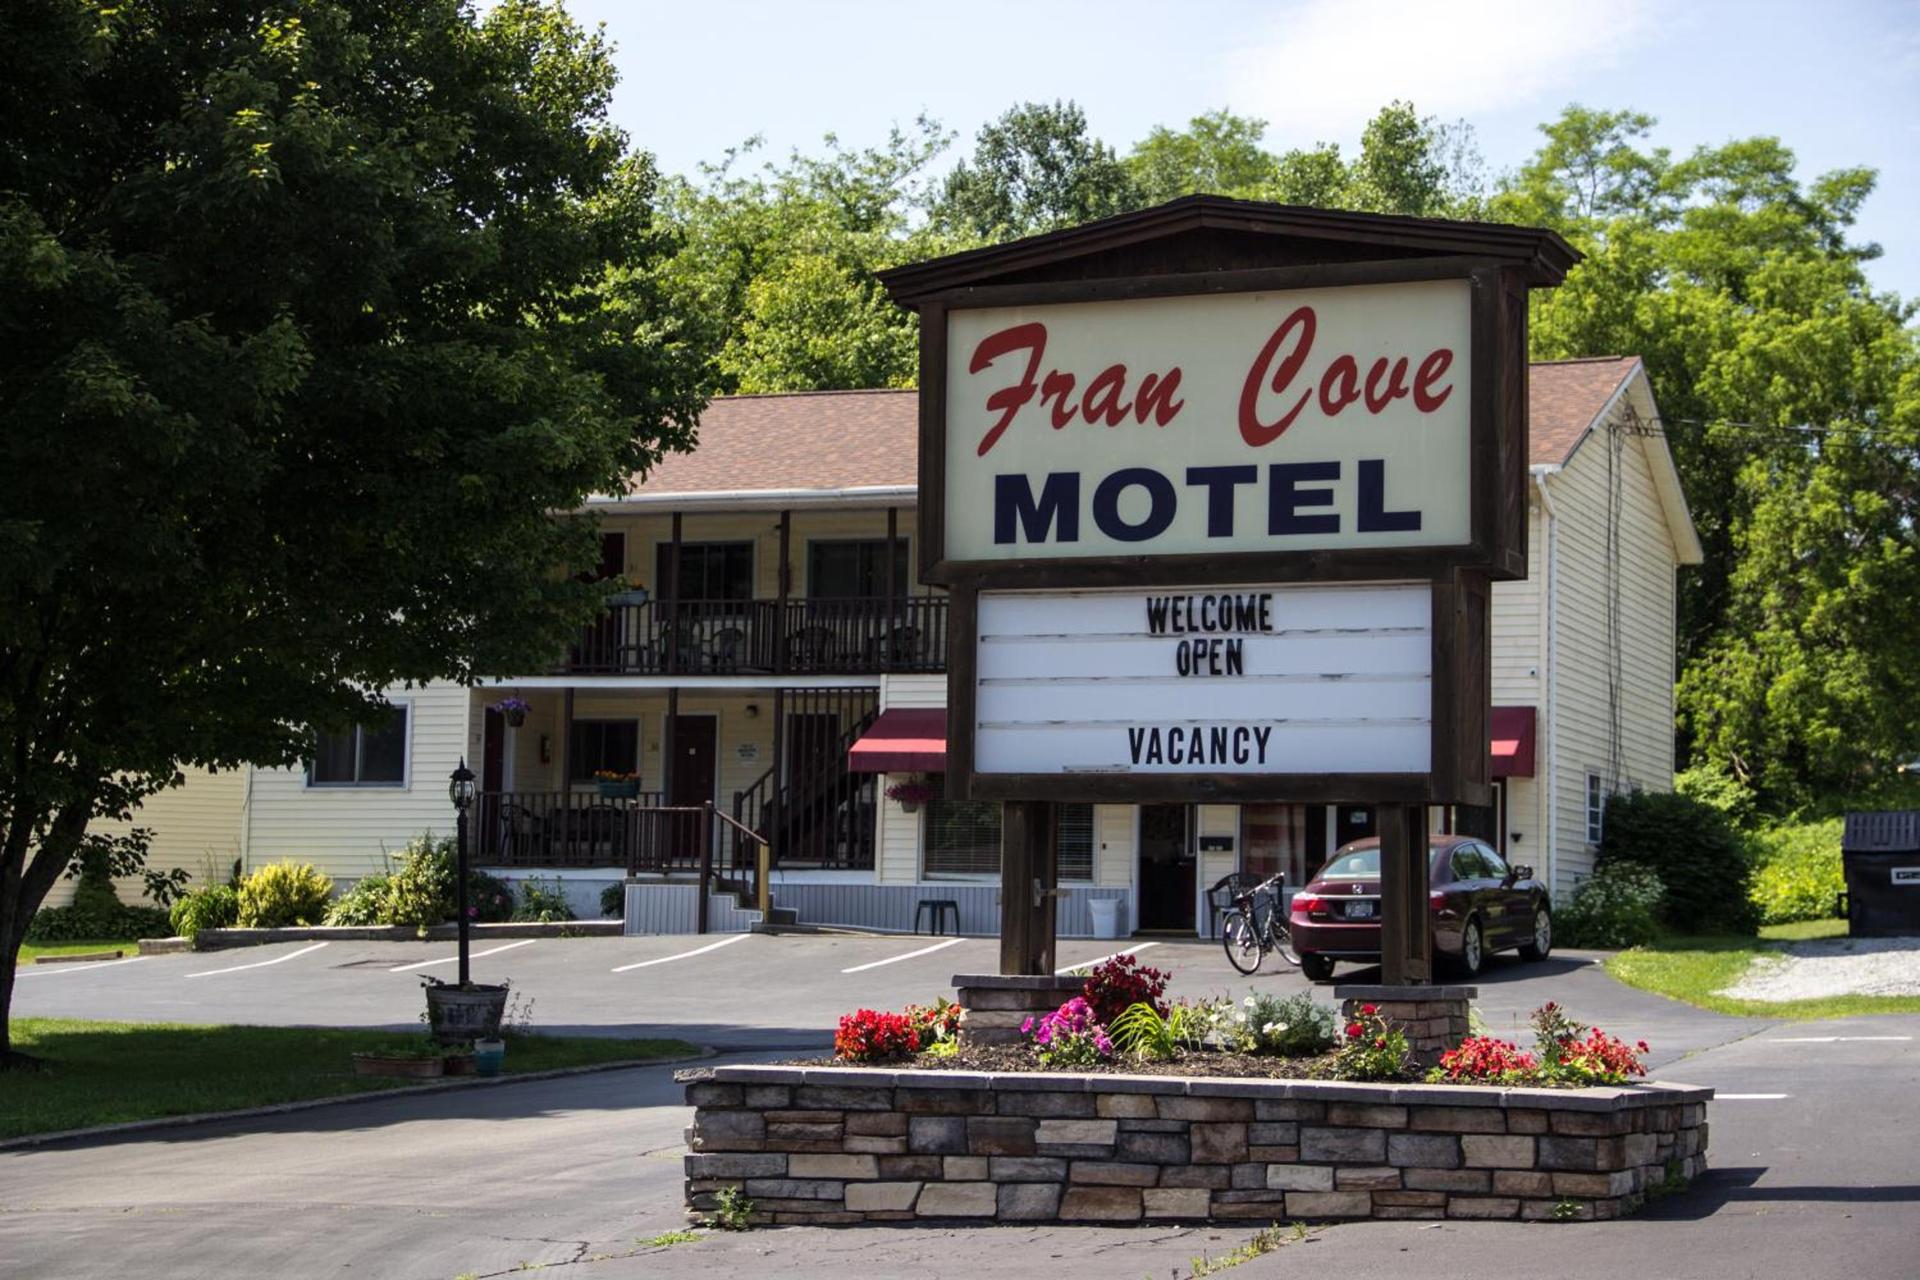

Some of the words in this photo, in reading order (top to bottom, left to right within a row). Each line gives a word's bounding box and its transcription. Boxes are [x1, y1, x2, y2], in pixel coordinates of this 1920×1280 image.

[969, 322, 1183, 456] Fran
[1239, 307, 1453, 447] Cove
[994, 459, 1422, 545] MOTEL
[1146, 593, 1273, 635] WELCOME
[1176, 638, 1243, 677] OPEN
[1128, 726, 1272, 765] VACANCY
